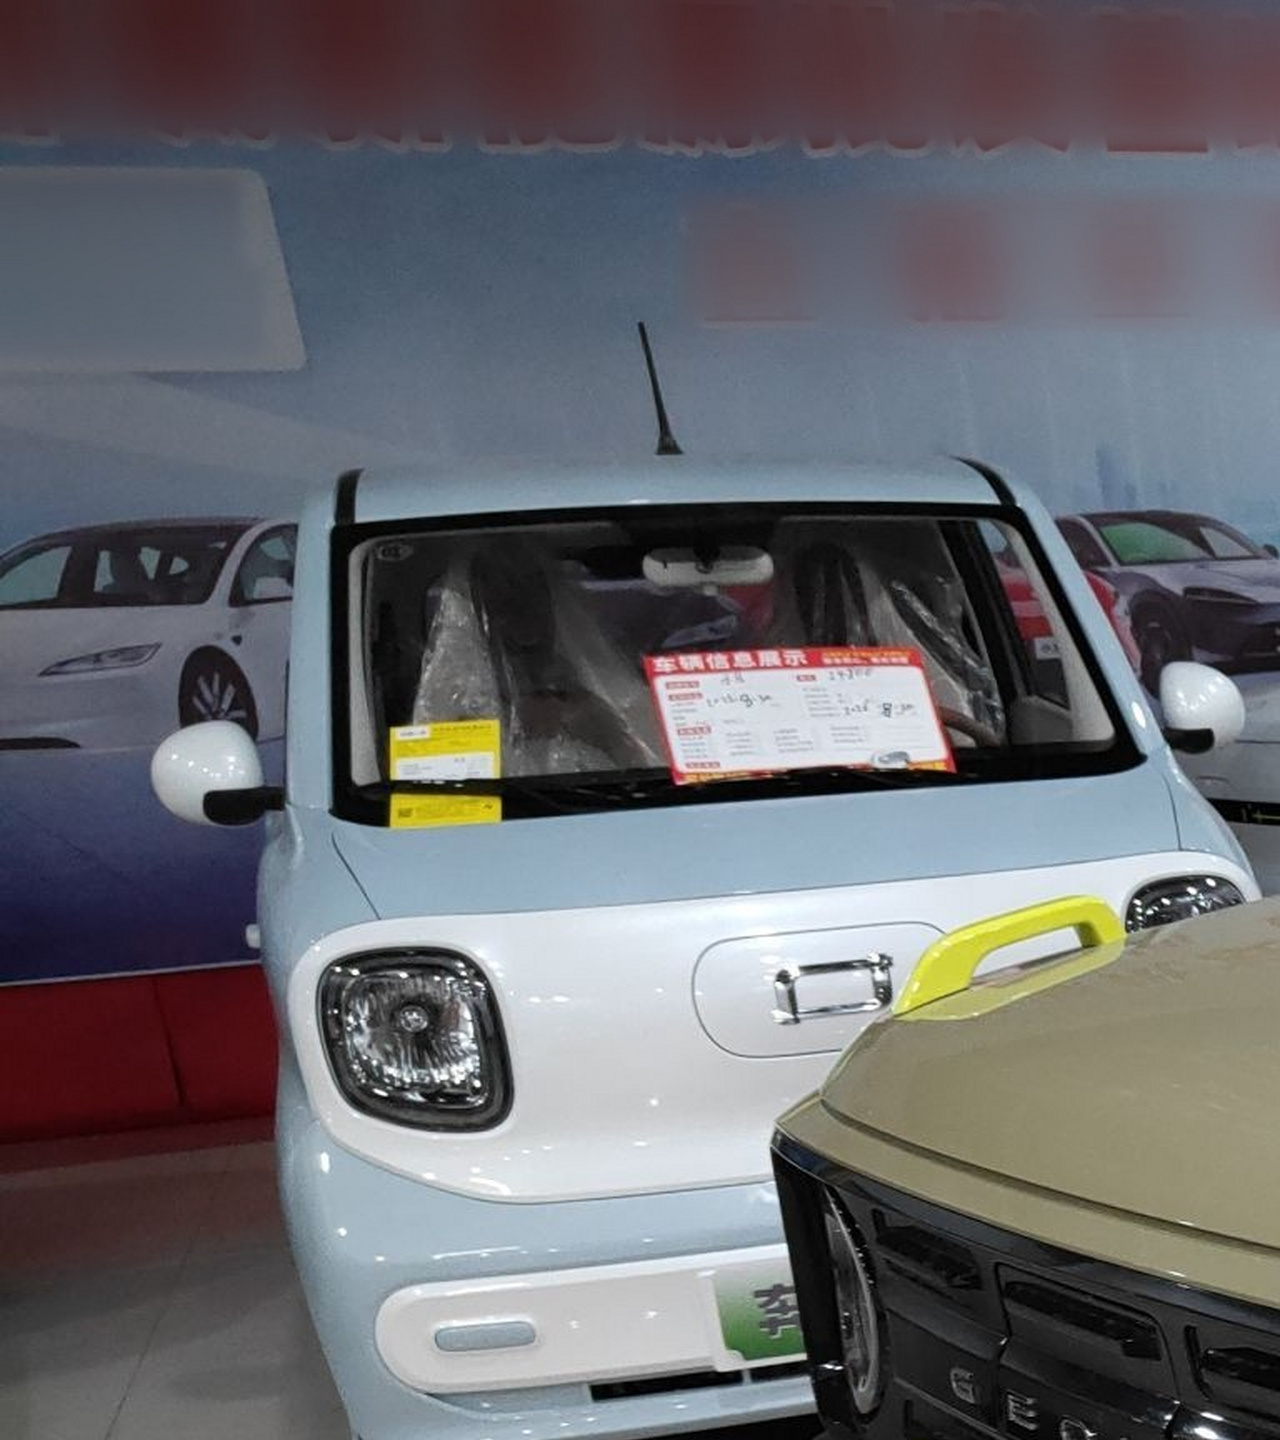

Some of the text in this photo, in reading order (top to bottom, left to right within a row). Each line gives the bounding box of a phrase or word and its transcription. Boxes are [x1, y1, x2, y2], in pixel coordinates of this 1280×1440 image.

[653, 651, 808, 672] 车辆信息展示
